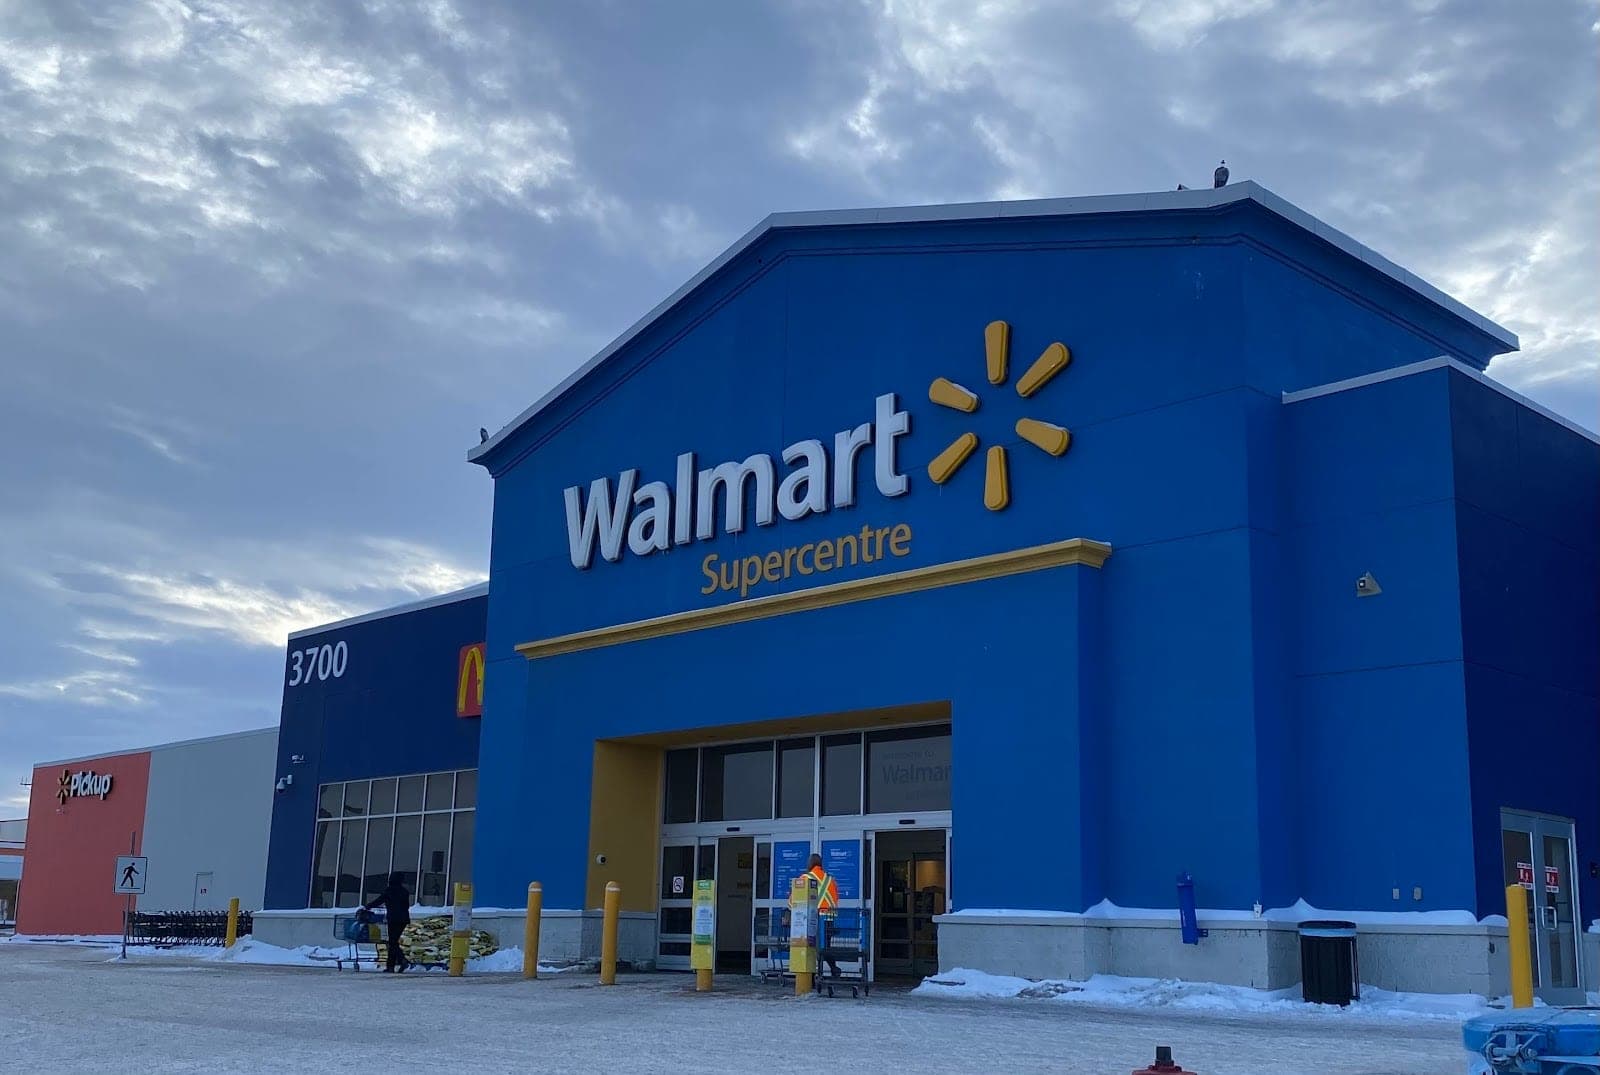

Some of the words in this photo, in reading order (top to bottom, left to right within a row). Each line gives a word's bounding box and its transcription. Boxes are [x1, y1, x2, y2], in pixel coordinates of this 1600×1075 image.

[564, 392, 910, 570] Walmart
[701, 523, 912, 598] Supercentre
[289, 640, 348, 687] 3700
[70, 770, 113, 801] Pickup
